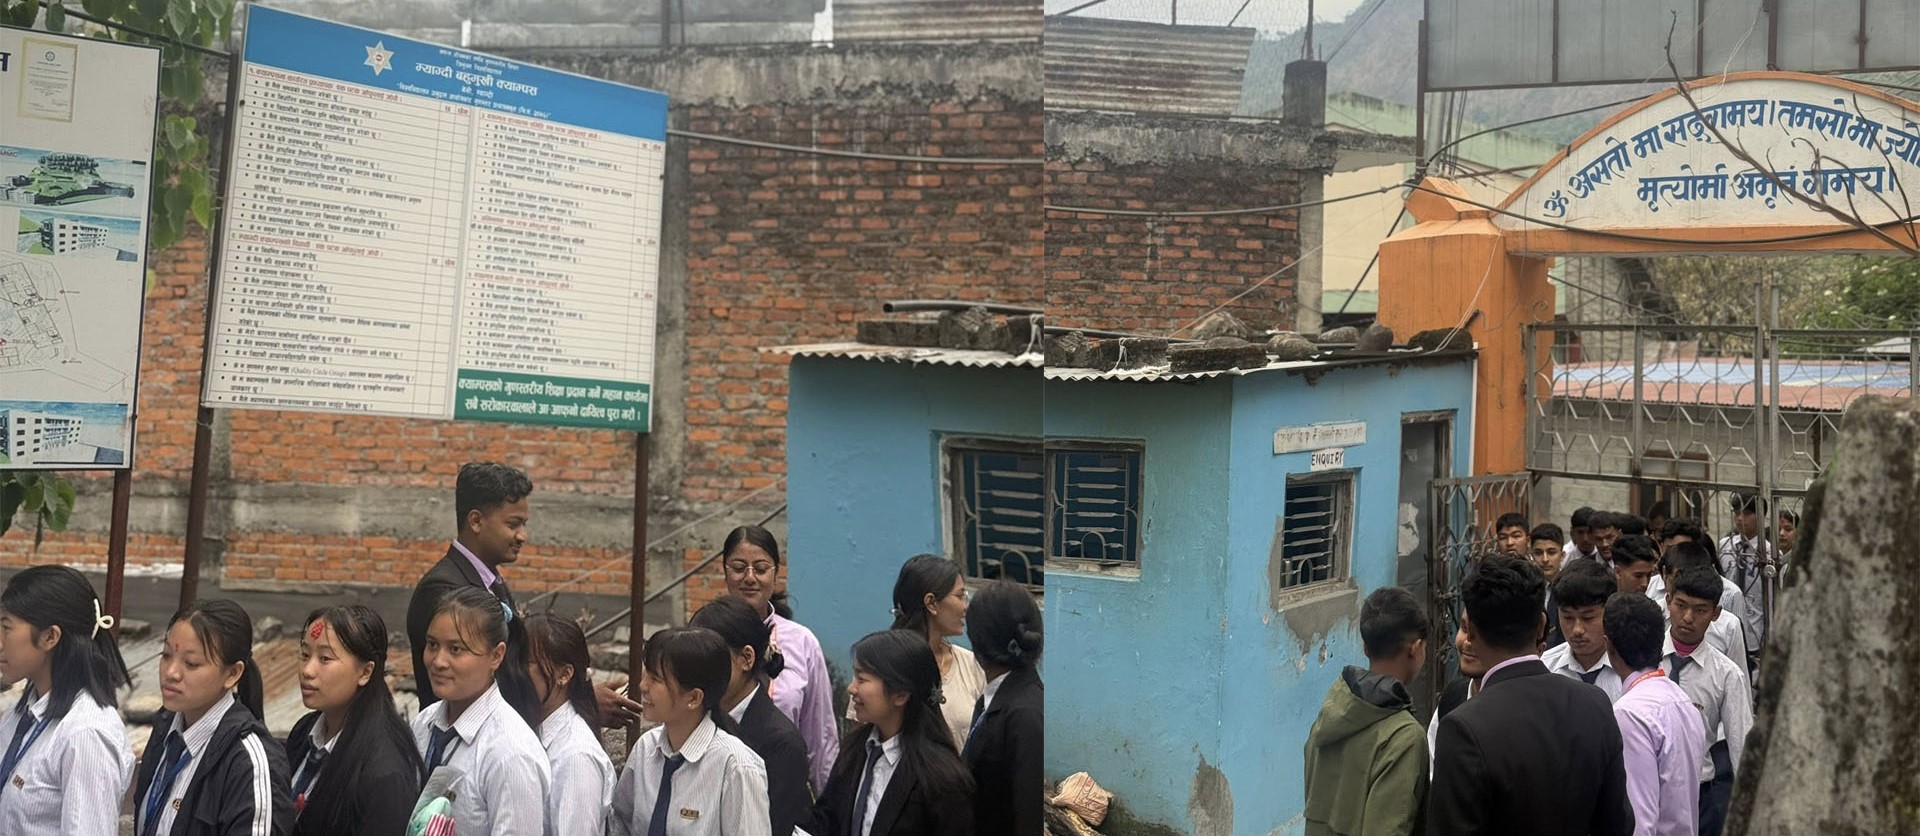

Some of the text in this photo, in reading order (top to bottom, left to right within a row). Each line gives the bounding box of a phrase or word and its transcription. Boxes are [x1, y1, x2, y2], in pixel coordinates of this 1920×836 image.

[415, 62, 538, 96] म्याग्दी बहुमुखी क्याम्पस
[1543, 190, 1569, 218] ॐ
[1568, 136, 1632, 199] असतो
[1630, 125, 1664, 159] मा
[1778, 98, 1854, 142] तमसो
[1848, 116, 1883, 151] मा
[1637, 163, 1729, 212] मृत्योर्मा
[458, 378, 503, 391] क्याम्पसको
[504, 381, 543, 395] गुणस्तरीय
[545, 381, 565, 397] शिक्षा
[566, 386, 586, 398] प्रदान
[465, 396, 478, 410] सबै
[480, 397, 536, 414] सरोकारवालाले
[580, 403, 605, 418] दायित्व
[1312, 451, 1344, 467] ENQUIRY
